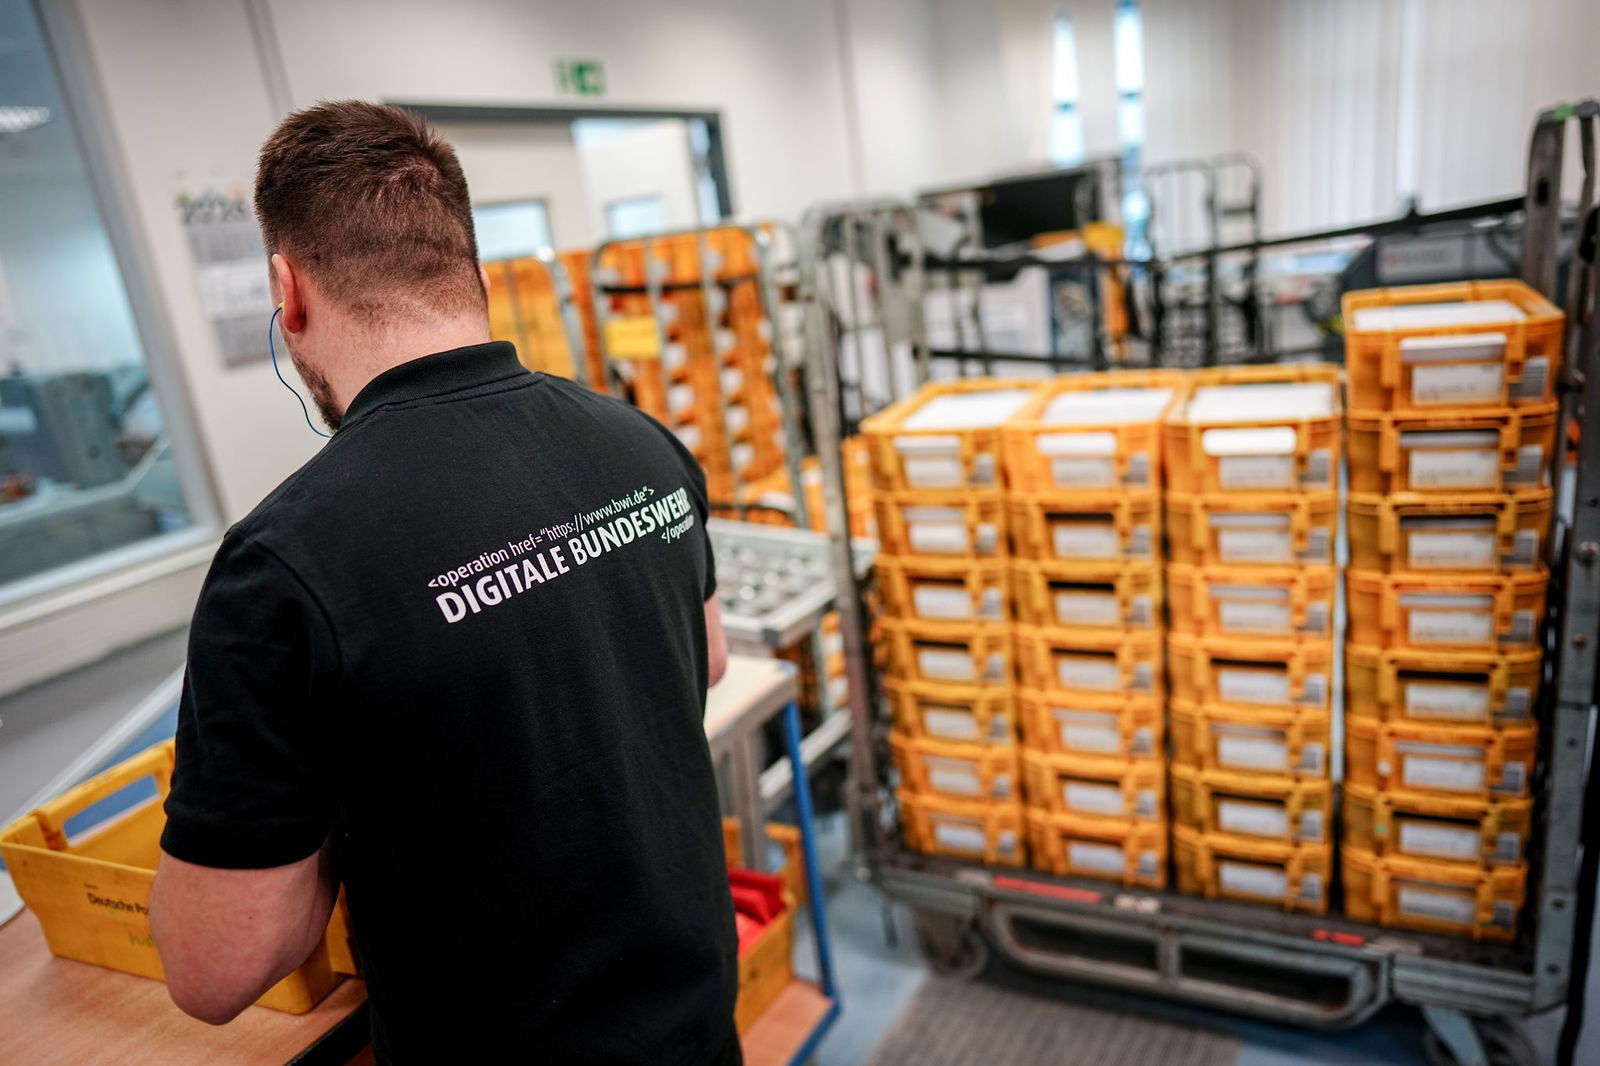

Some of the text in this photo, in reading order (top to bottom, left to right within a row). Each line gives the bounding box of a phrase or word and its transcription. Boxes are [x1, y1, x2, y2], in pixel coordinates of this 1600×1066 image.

[427, 549, 510, 588] <operation
[435, 486, 691, 624] DIGITALE BUNDESWEHR
[134, 902, 150, 916] Po
